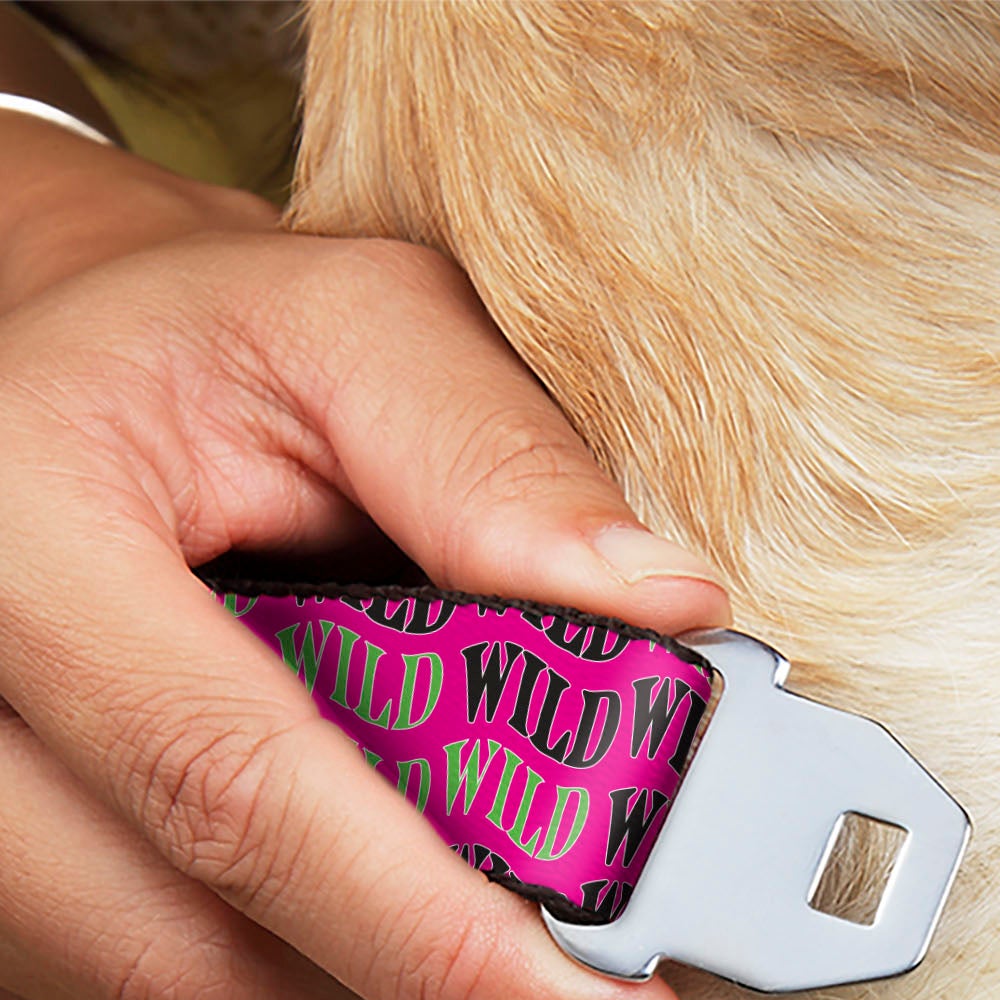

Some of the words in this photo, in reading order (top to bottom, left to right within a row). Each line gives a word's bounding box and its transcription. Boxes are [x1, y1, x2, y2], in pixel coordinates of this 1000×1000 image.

[275, 620, 443, 730] WILD
[460, 641, 622, 769] WILD
[632, 675, 709, 776] WI
[443, 738, 590, 861] WILD
